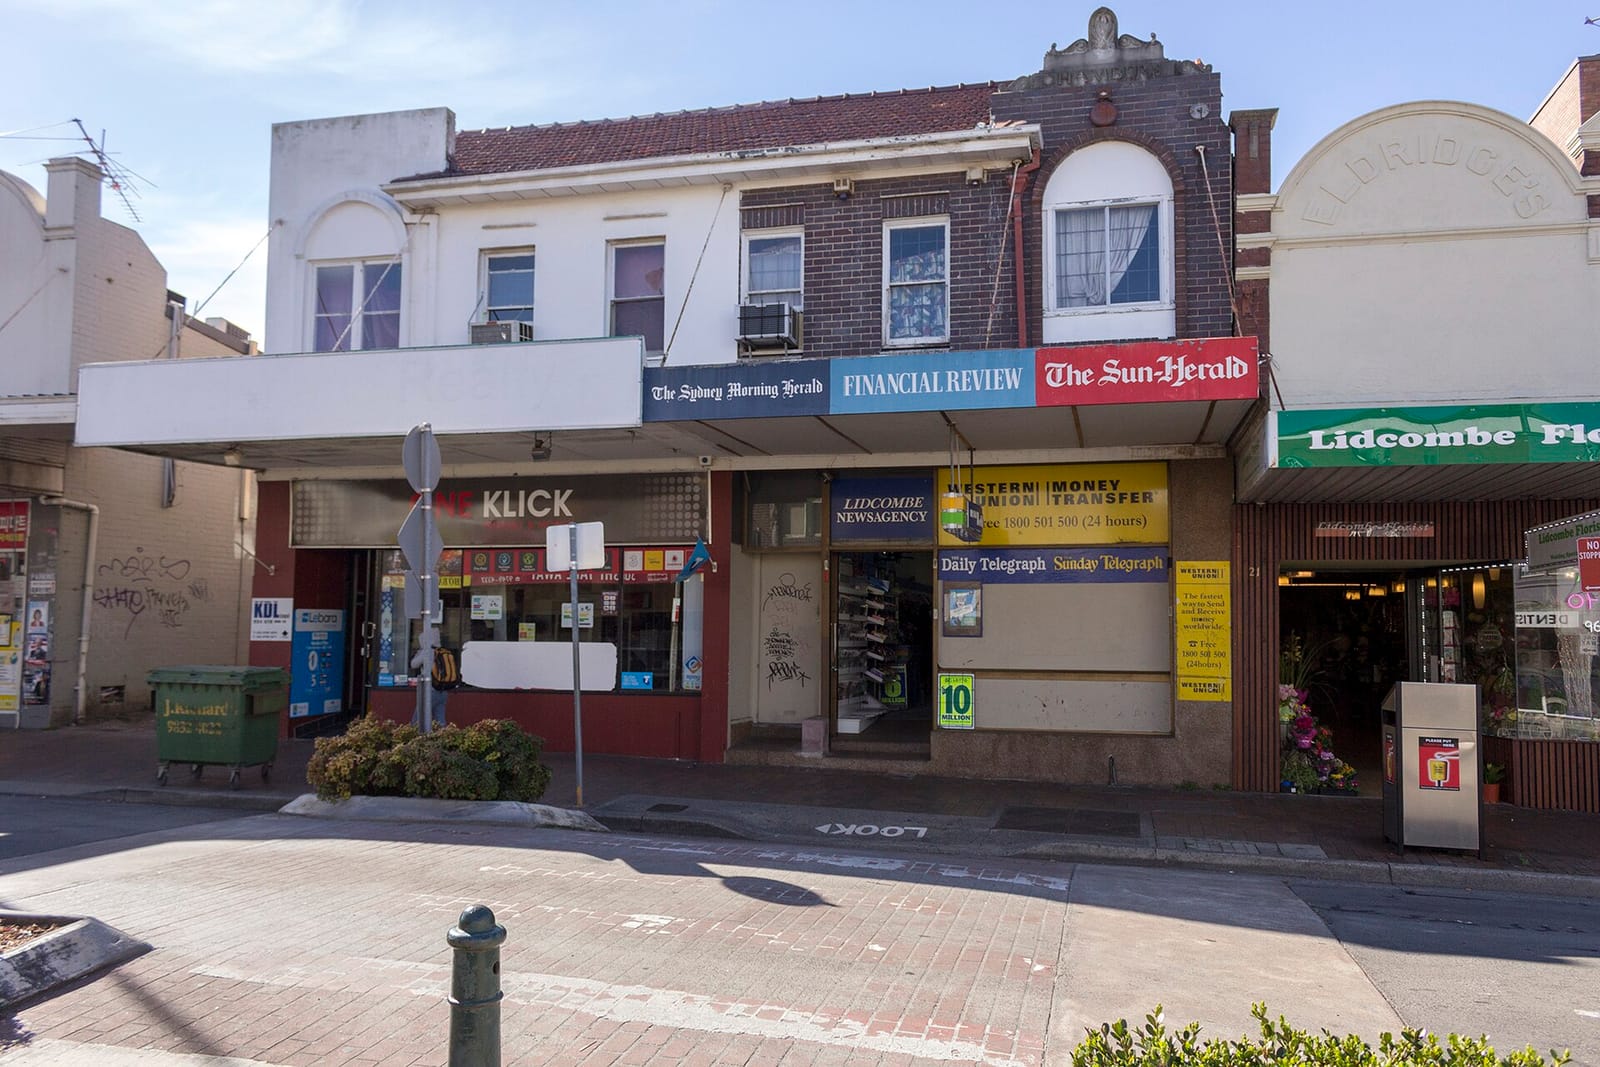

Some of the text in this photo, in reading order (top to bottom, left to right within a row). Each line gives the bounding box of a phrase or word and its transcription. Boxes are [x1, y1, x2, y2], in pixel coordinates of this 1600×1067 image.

[1044, 354, 1249, 388] The Sun-Herald
[843, 367, 1024, 397] FINANCIAL REVIEW
[651, 378, 824, 403] The Sydney Morning Herald
[1308, 426, 1516, 450] Lidcombe
[1052, 480, 1120, 492] MONEY
[482, 489, 574, 518] KLICK
[843, 496, 925, 510] LIDCOMBE
[975, 493, 1034, 507] UNION
[1052, 491, 1154, 506] TRANSFER
[836, 511, 928, 523] NEWSAGENCY
[983, 517, 1000, 529] ree
[1004, 516, 1031, 529] 1800
[1033, 516, 1054, 529] 501
[1058, 515, 1078, 528] 500
[1081, 514, 1101, 529] (24
[1105, 513, 1148, 530] hours)
[1539, 528, 1574, 545] Lidcombe
[1587, 541, 1600, 550] NO
[941, 557, 1046, 574] Daily Telegraph
[1054, 554, 1163, 573] Sunday Telegraph
[1249, 567, 1260, 577] 21
[1183, 592, 1223, 600] The fastest
[253, 602, 280, 619] KDL
[309, 612, 337, 623] Lebara
[1200, 640, 1217, 648] Free
[1182, 650, 1198, 658] 1800
[831, 823, 928, 838] LOOK
